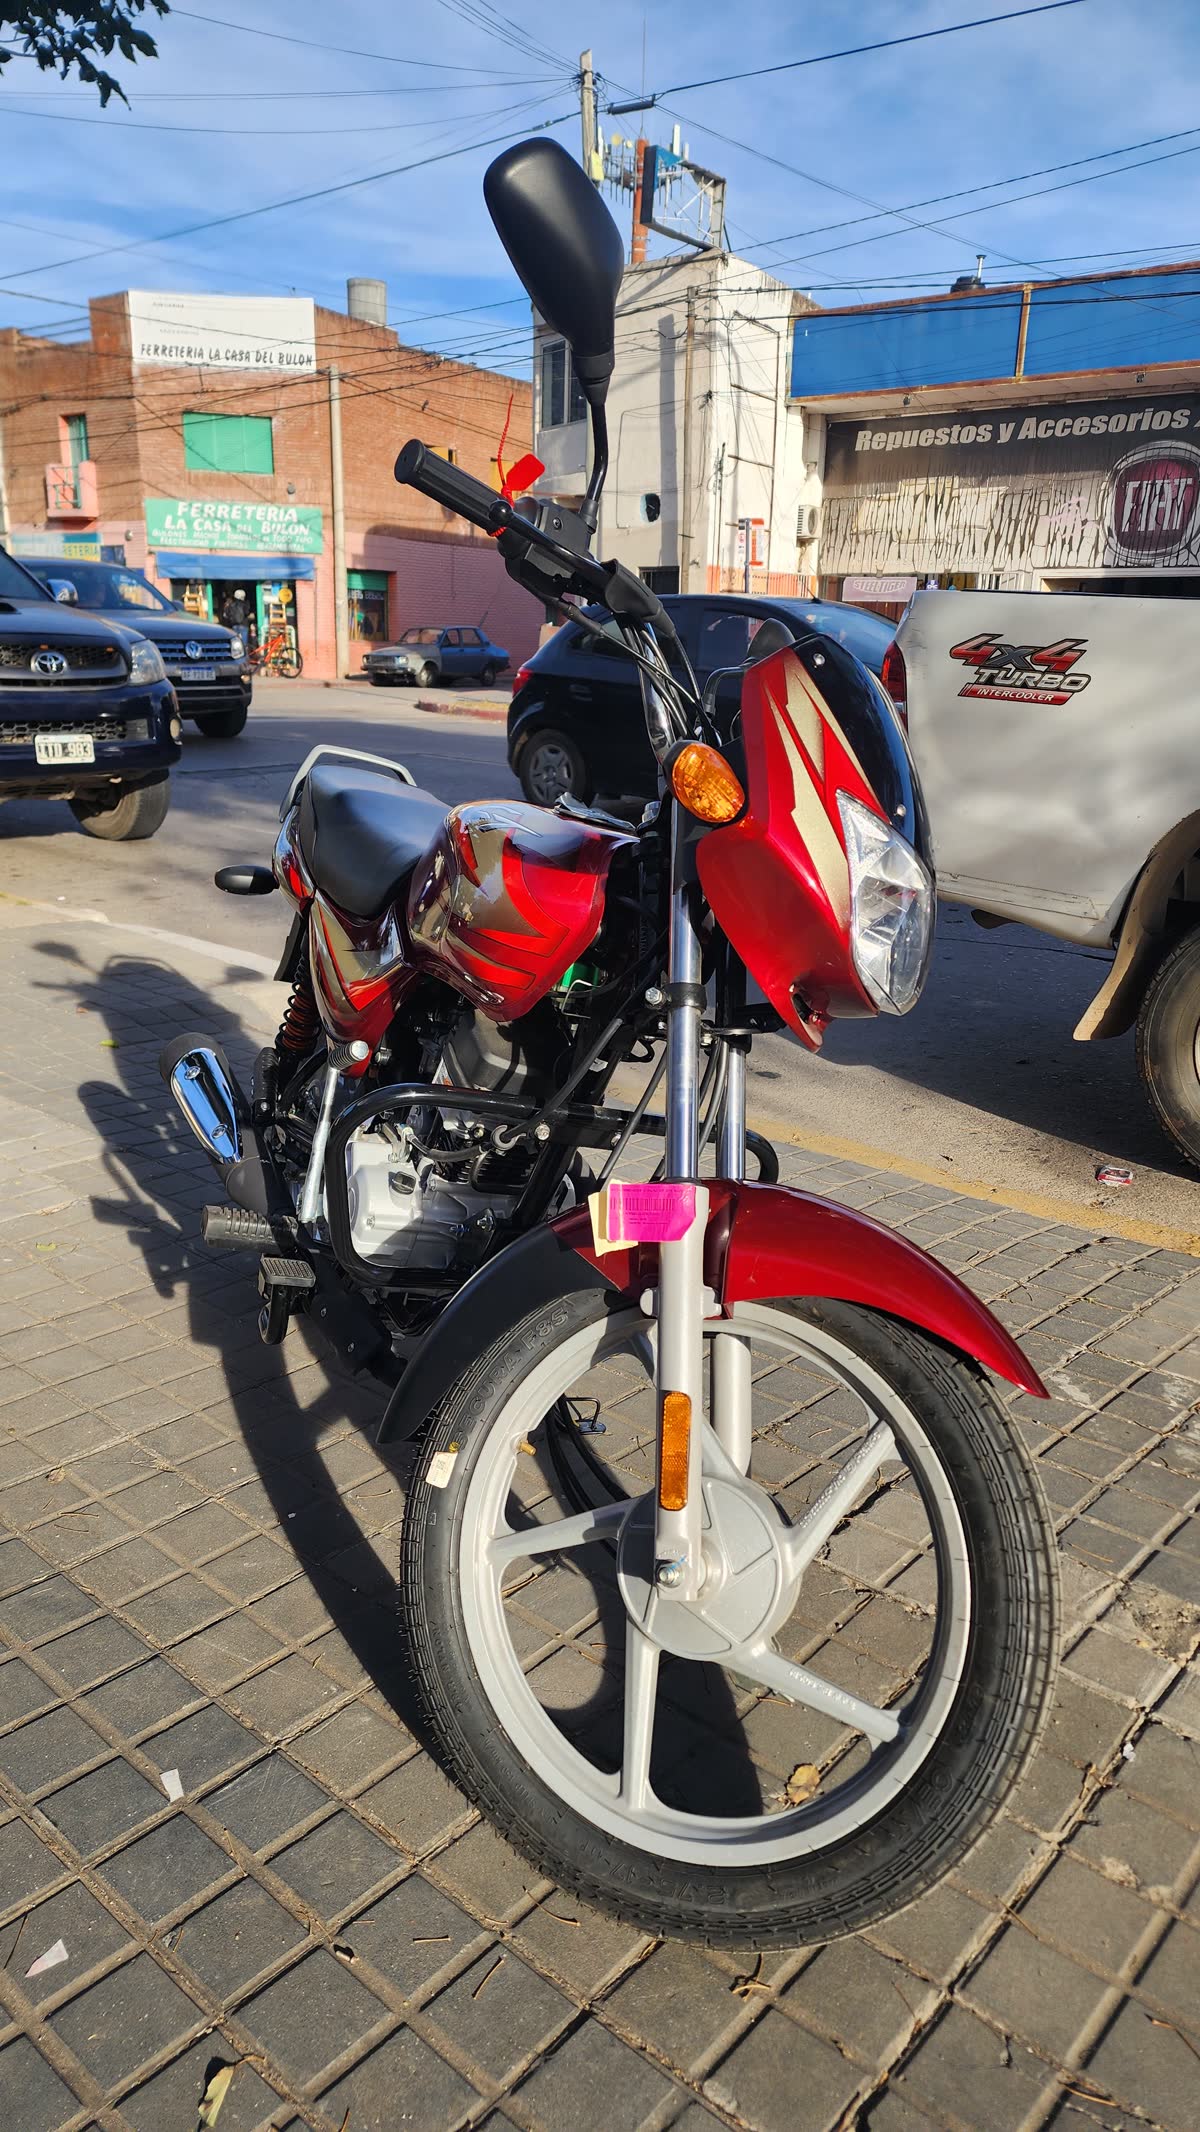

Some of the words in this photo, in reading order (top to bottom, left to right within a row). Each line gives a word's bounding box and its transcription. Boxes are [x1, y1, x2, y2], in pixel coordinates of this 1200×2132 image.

[141, 343, 204, 359] FERRETERIA
[208, 349, 221, 360] LA
[224, 350, 251, 362] CASA
[255, 351, 274, 364] DEL
[855, 423, 993, 451] Repuestos
[997, 422, 1016, 444] y
[1017, 407, 1190, 441] Accesorios
[177, 501, 298, 523] FERRETERIA
[1121, 478, 1192, 532] FIAT
[164, 515, 188, 531] LA
[193, 517, 232, 533] CASA
[261, 522, 310, 536] BULON
[950, 633, 1088, 673] 4x4
[976, 667, 1091, 691] TURBO
[977, 688, 1055, 702] INTERCOOLER
[453, 1353, 521, 1449] SECURA
[521, 1307, 569, 1350] F85
